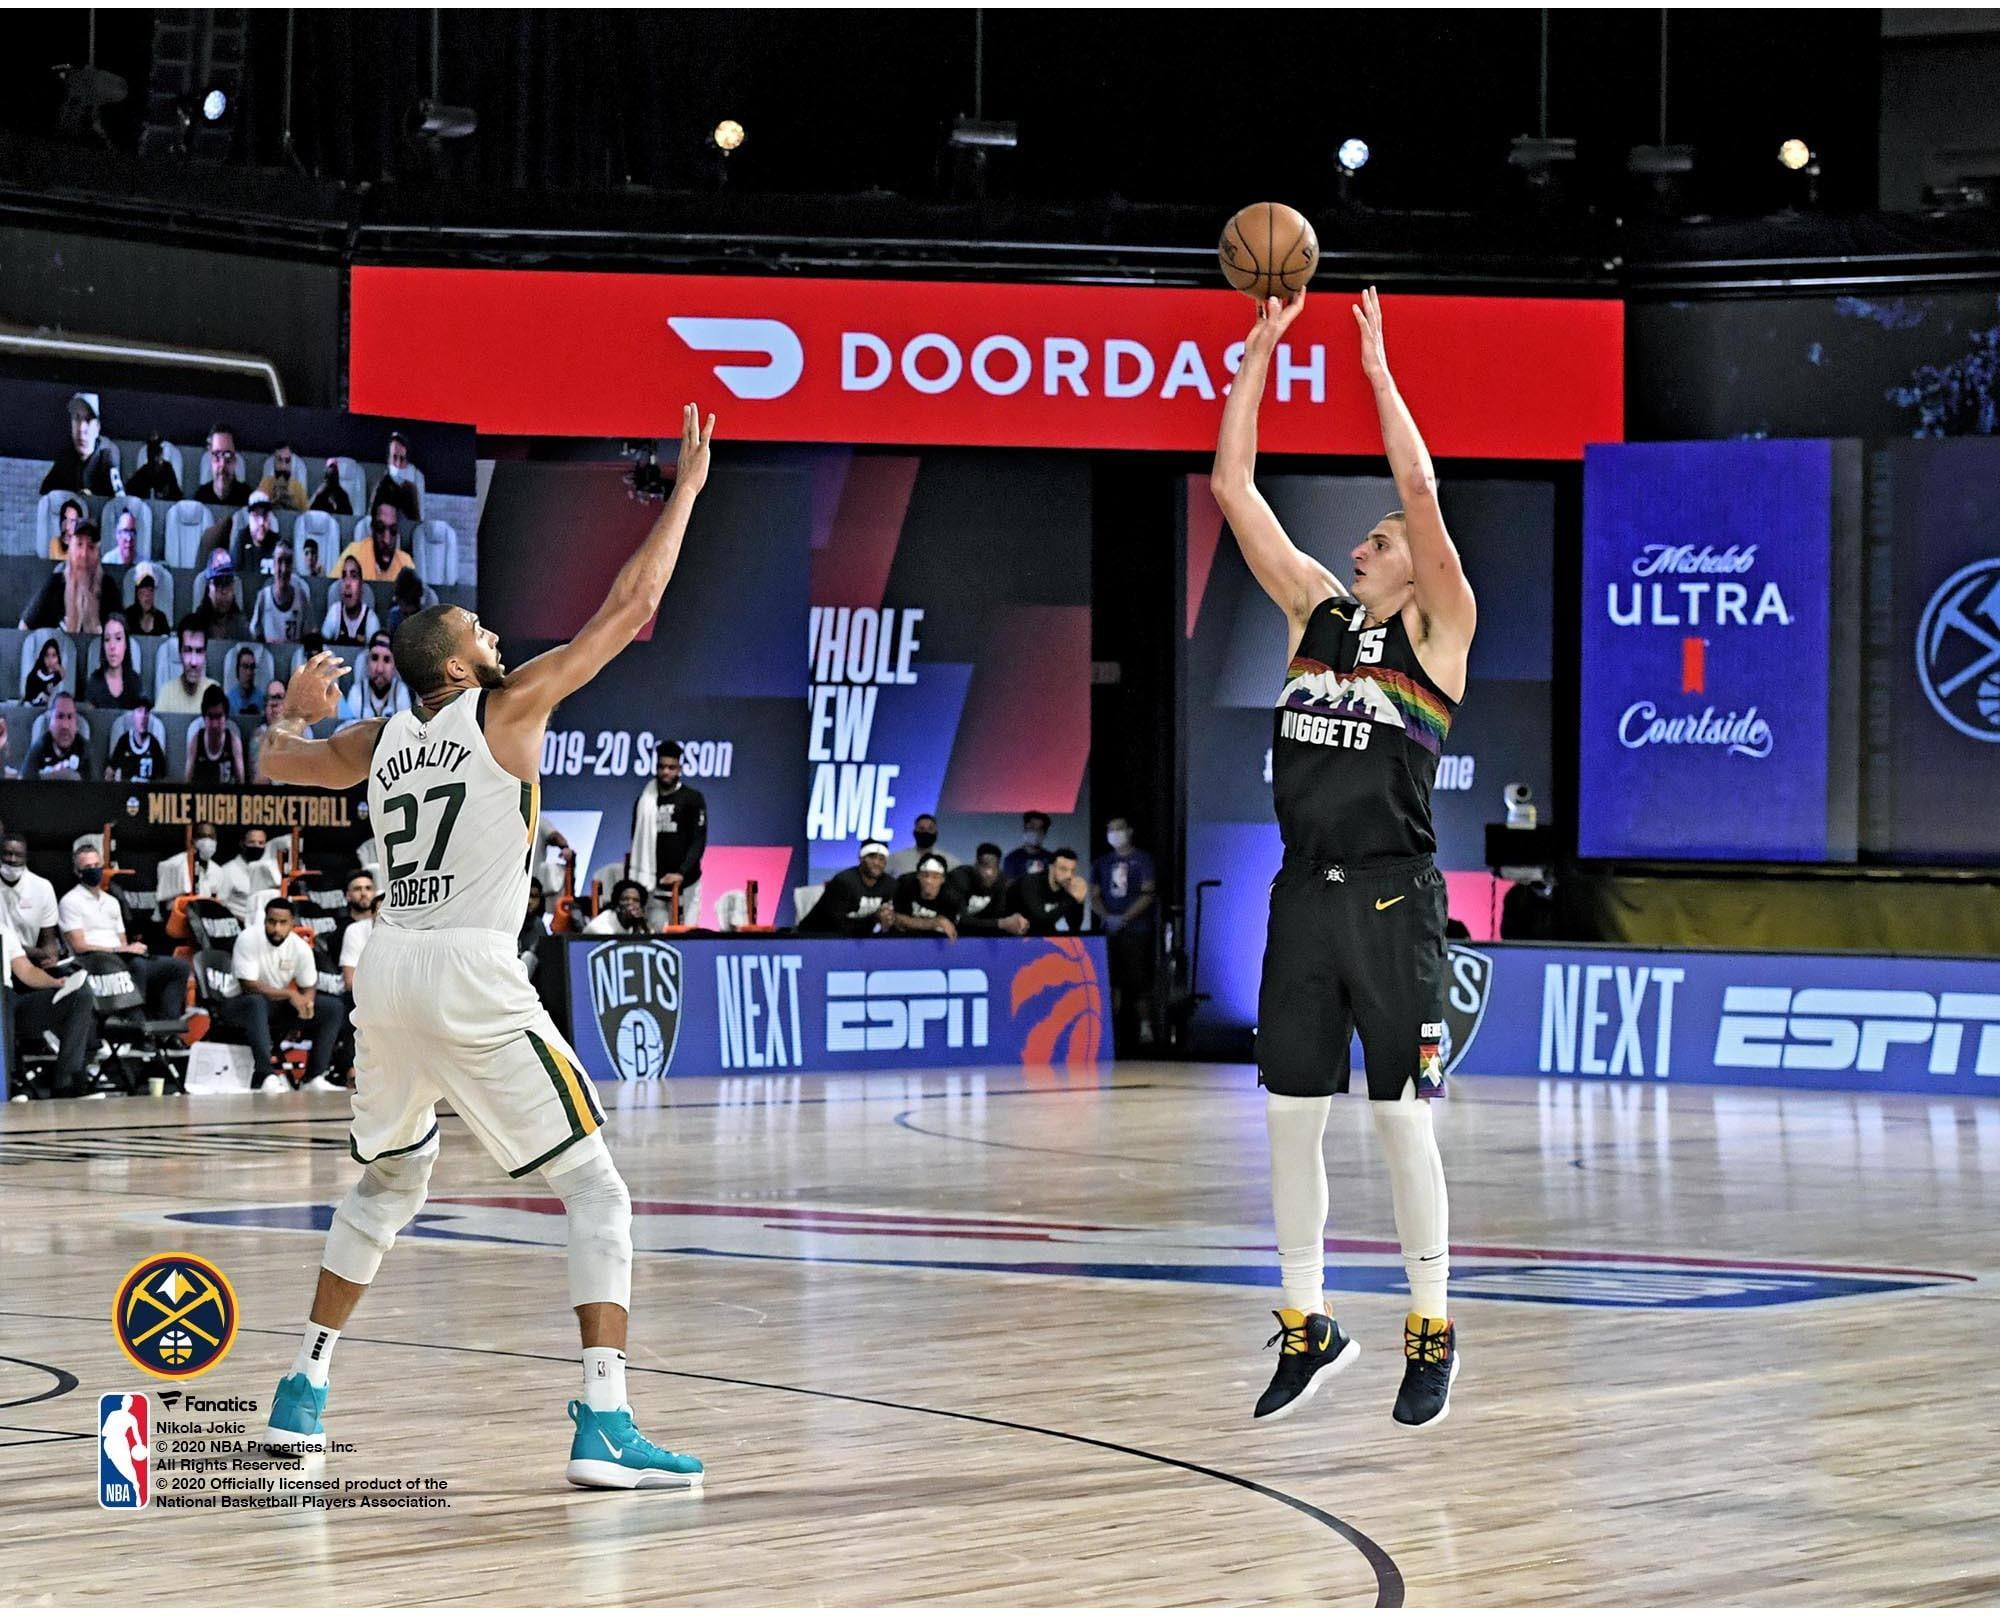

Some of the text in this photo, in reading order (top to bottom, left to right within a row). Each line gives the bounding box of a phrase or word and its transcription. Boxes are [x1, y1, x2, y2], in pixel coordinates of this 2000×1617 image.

[1632, 544, 1759, 577] Michelob
[1608, 582, 1792, 626] ULTRA
[808, 685, 879, 762] EW
[1281, 710, 1372, 751] NUGGETS
[1618, 701, 1773, 758] Courtside
[376, 740, 472, 792] EQUALITY
[633, 731, 733, 778] Sson
[148, 793, 351, 828] MILE HIGH BASKETBALL
[383, 782, 467, 881] 27
[390, 875, 454, 908] GOBERT
[595, 945, 678, 1016] NETS
[716, 954, 989, 1068] NEXT ESPN
[1538, 963, 1685, 1078] NEXT
